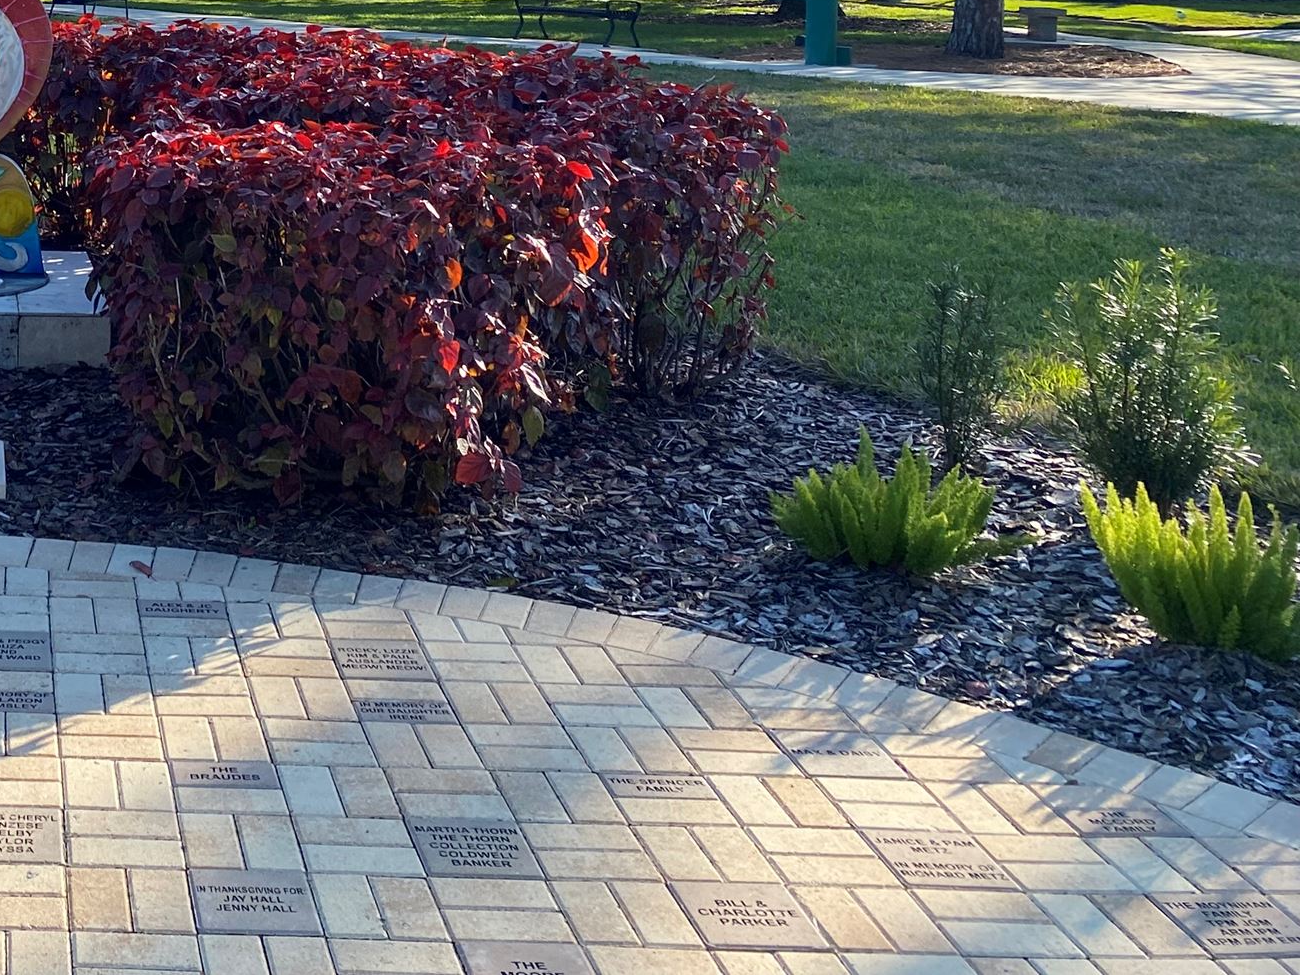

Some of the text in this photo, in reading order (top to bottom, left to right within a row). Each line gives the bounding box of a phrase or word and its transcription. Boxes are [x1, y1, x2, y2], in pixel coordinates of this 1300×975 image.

[461, 835, 510, 843] THORN
[876, 837, 926, 845] JANICE
[429, 842, 519, 851] COLLECTION
[439, 851, 519, 860] COLDWELL
[451, 860, 512, 868] BANKER
[912, 862, 973, 871] MEMORY
[900, 870, 1010, 881] RICHARD METZ
[209, 886, 281, 894] THANKSGIVING
[714, 899, 752, 907] BILL
[262, 905, 297, 913] HALL
[698, 908, 800, 917] CHARLOTTE
[720, 918, 789, 926] PARKER
[511, 961, 547, 970] THE
